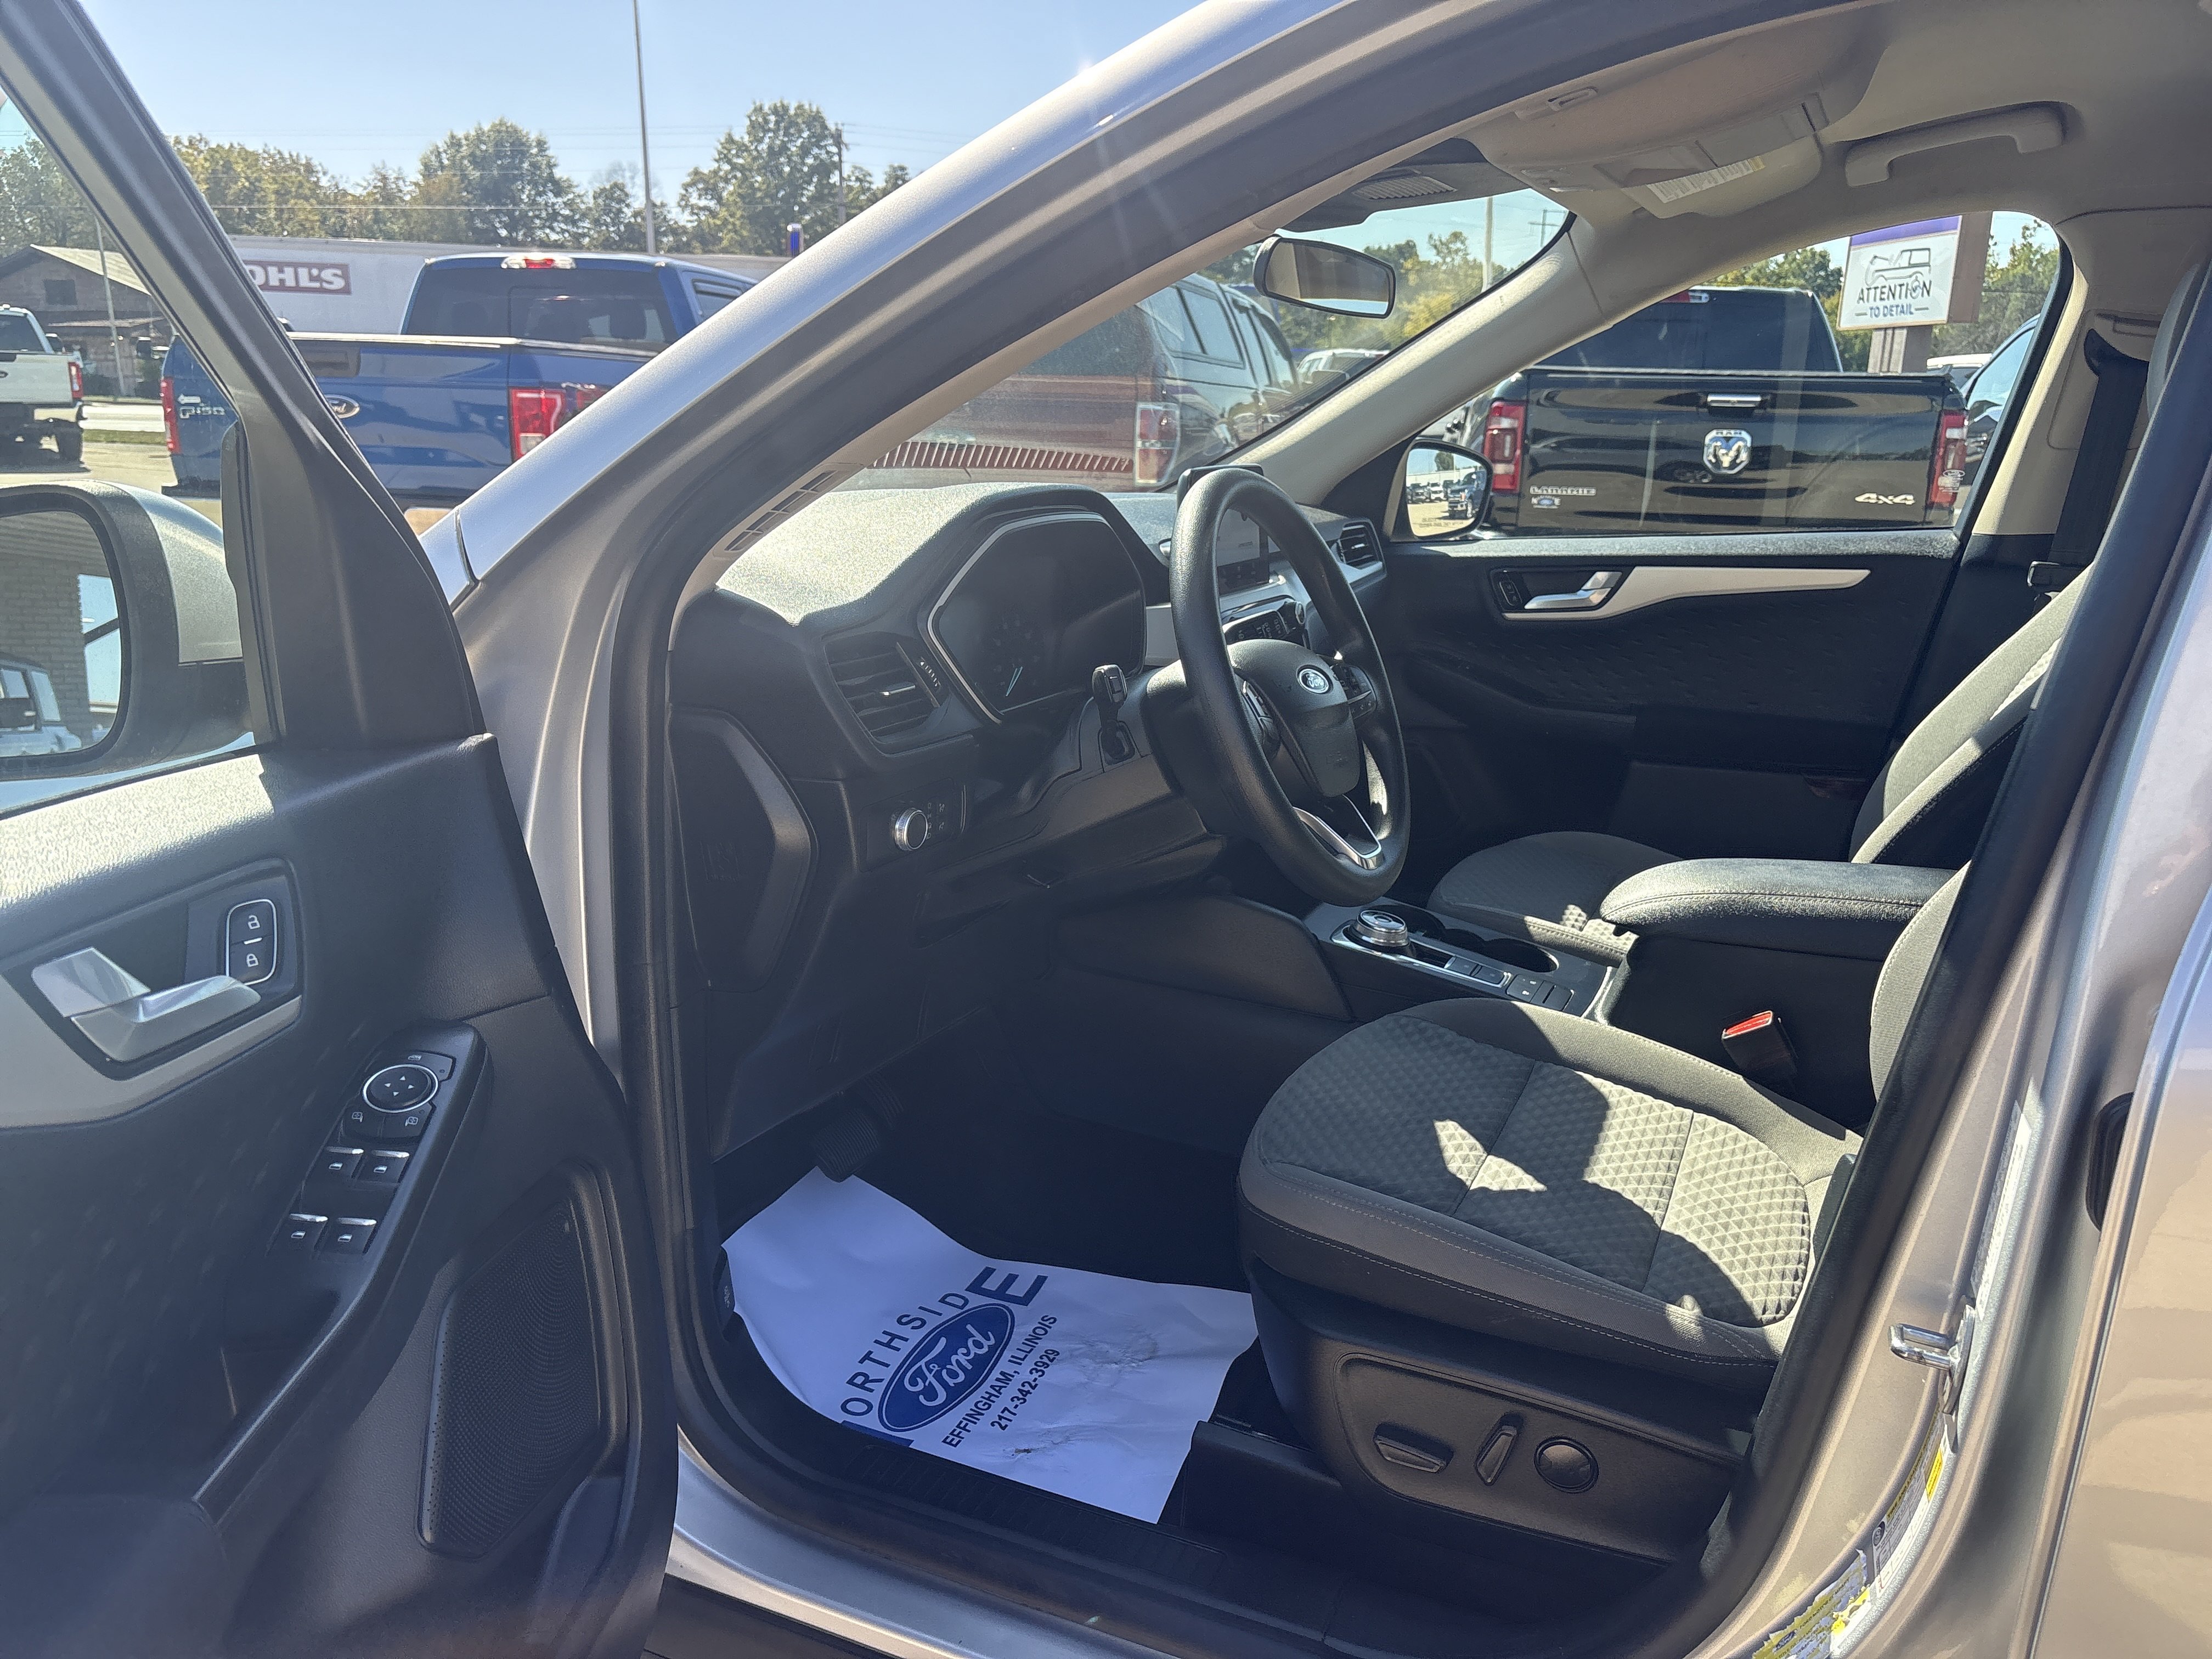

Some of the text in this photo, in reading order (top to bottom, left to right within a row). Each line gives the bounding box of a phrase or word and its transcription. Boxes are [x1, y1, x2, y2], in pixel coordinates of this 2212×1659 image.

[246, 264, 346, 290] OHL'S
[1857, 279, 1932, 304] ATTENTION
[1869, 303, 1914, 318] TO DETAIL
[840, 1266, 1048, 1447] ORTHSIDE
[904, 1323, 996, 1407] Ford
[941, 1314, 1058, 1448] EFFINGHAM, ILLINOIS
[990, 1348, 1060, 1431] 217-342-3929
